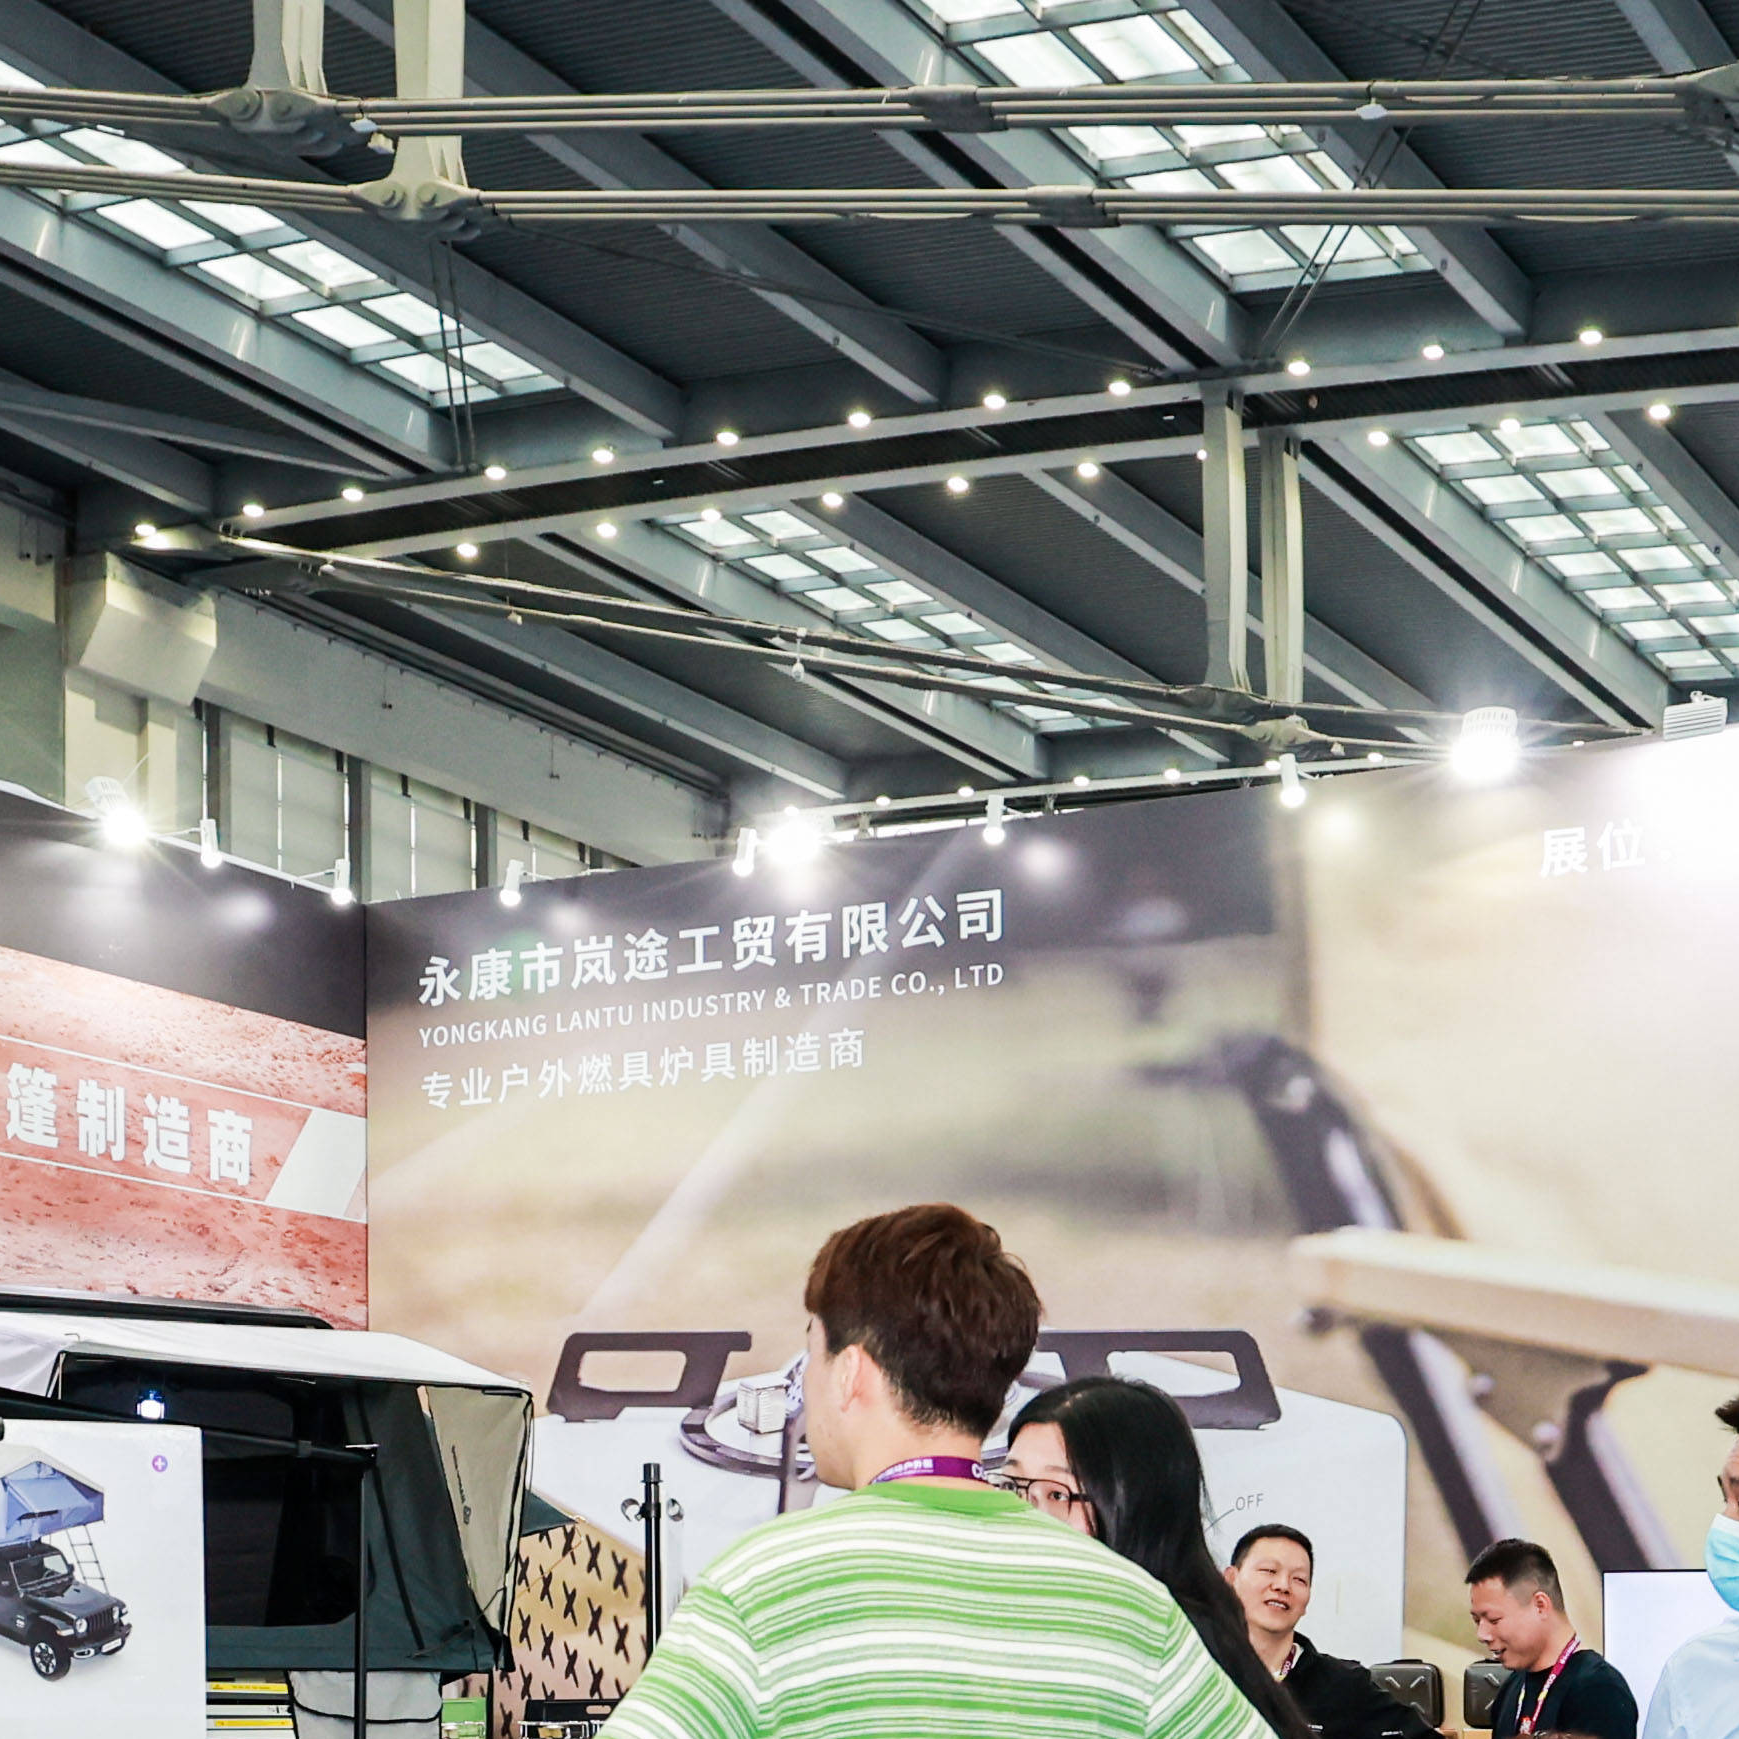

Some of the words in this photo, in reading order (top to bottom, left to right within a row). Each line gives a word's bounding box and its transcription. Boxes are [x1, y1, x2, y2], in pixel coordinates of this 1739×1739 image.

[418, 889, 1004, 1007] 永康市岚途工贸有限公司
[420, 1014, 548, 1048] YONGKANG
[556, 1004, 635, 1035] LANTU
[643, 989, 767, 1024] INDUSTRY
[774, 985, 792, 1009] &
[801, 976, 883, 1006] TRADE
[955, 963, 1005, 989] LTD
[421, 1027, 865, 1110] 专业户外燃具炉具制造商
[1235, 1493, 1264, 1511] OFF
